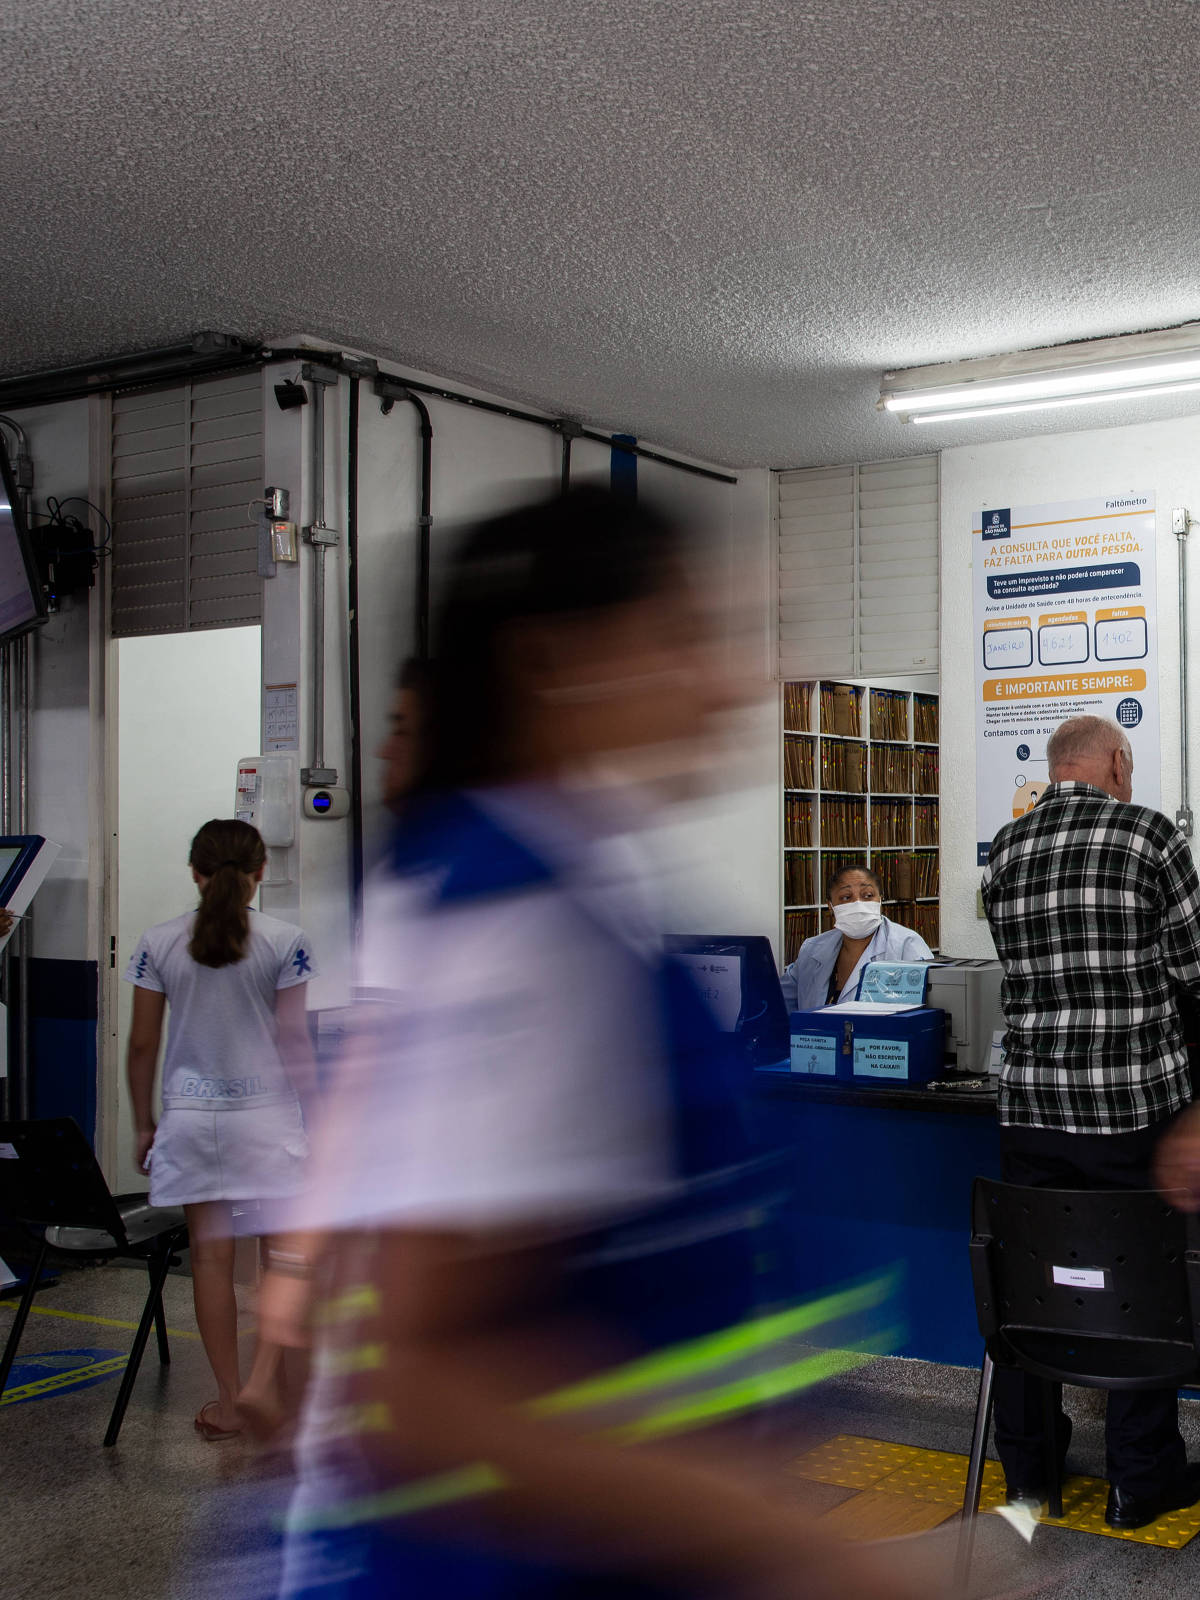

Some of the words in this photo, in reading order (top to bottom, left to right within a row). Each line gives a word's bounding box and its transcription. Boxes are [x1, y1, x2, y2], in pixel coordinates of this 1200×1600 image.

[1106, 498, 1147, 508] Faltômetro
[991, 546, 998, 555] A
[1000, 541, 1048, 554] CONSULTA
[1052, 539, 1071, 549] QUE
[1075, 534, 1099, 546] VOCÊ
[1102, 532, 1135, 543] FALTA,
[984, 558, 1001, 568] FAZ
[1005, 555, 1033, 566] FALTA
[1036, 553, 1062, 562] PARA
[1066, 548, 1098, 559] OUTRA
[1102, 543, 1143, 555] PESSOA.
[996, 684, 1002, 695] É
[1005, 678, 1078, 694] IMPORTANTE
[1082, 675, 1133, 690] SEMPRE:
[984, 729, 1018, 737] Contamos
[181, 1077, 267, 1097] BRASIL
